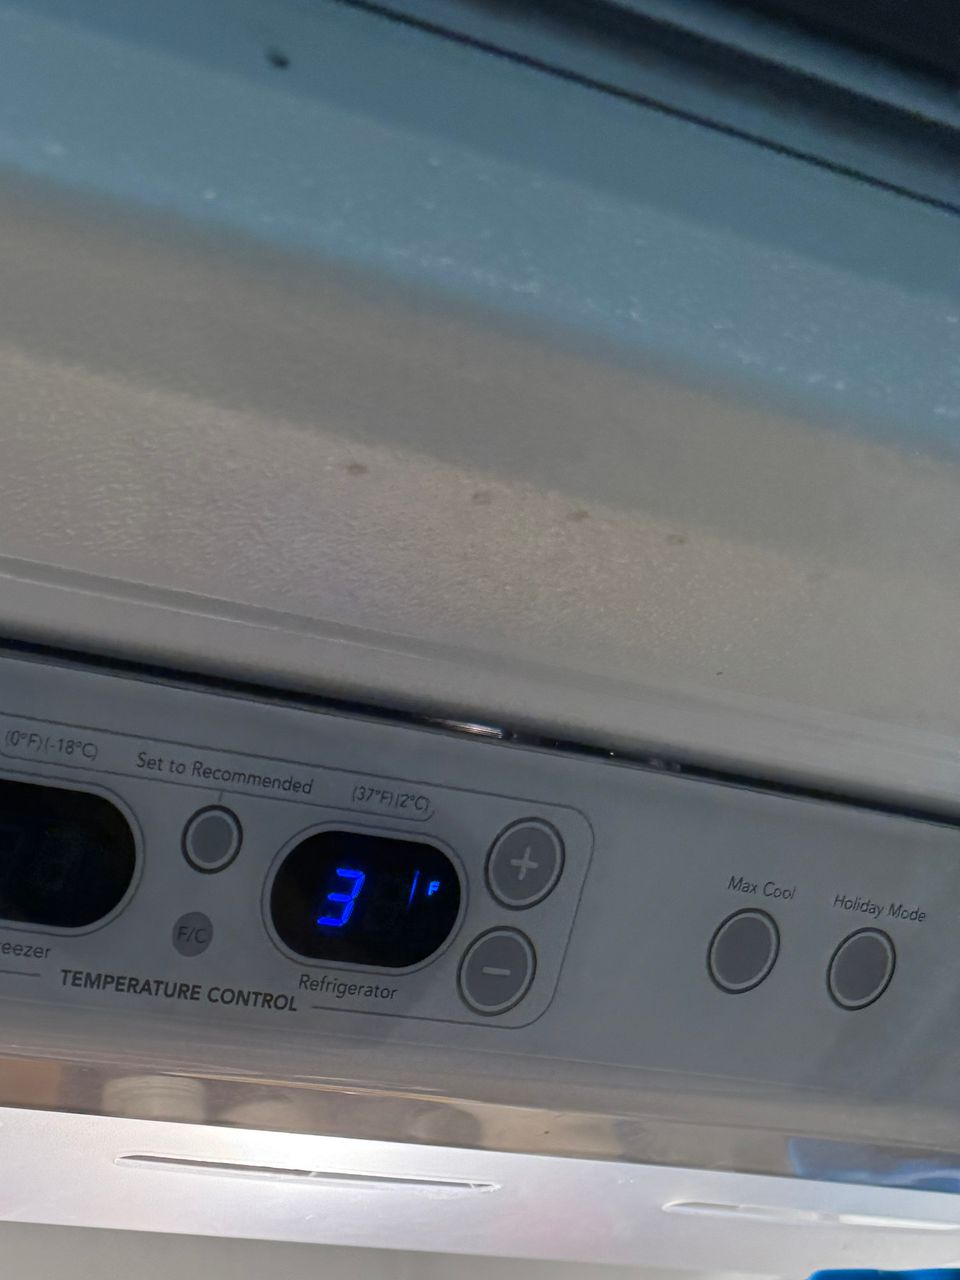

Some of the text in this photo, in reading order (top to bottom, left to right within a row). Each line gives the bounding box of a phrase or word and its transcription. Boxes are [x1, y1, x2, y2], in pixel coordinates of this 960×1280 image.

[136, 751, 315, 795] Set to Recommended
[727, 875, 796, 900] Max Cool
[833, 894, 927, 922] Holiday Mode
[177, 926, 208, 944] F/C
[60, 968, 298, 1012] TEMPERATURE CONTROL
[299, 973, 398, 1001] Refrigerator
